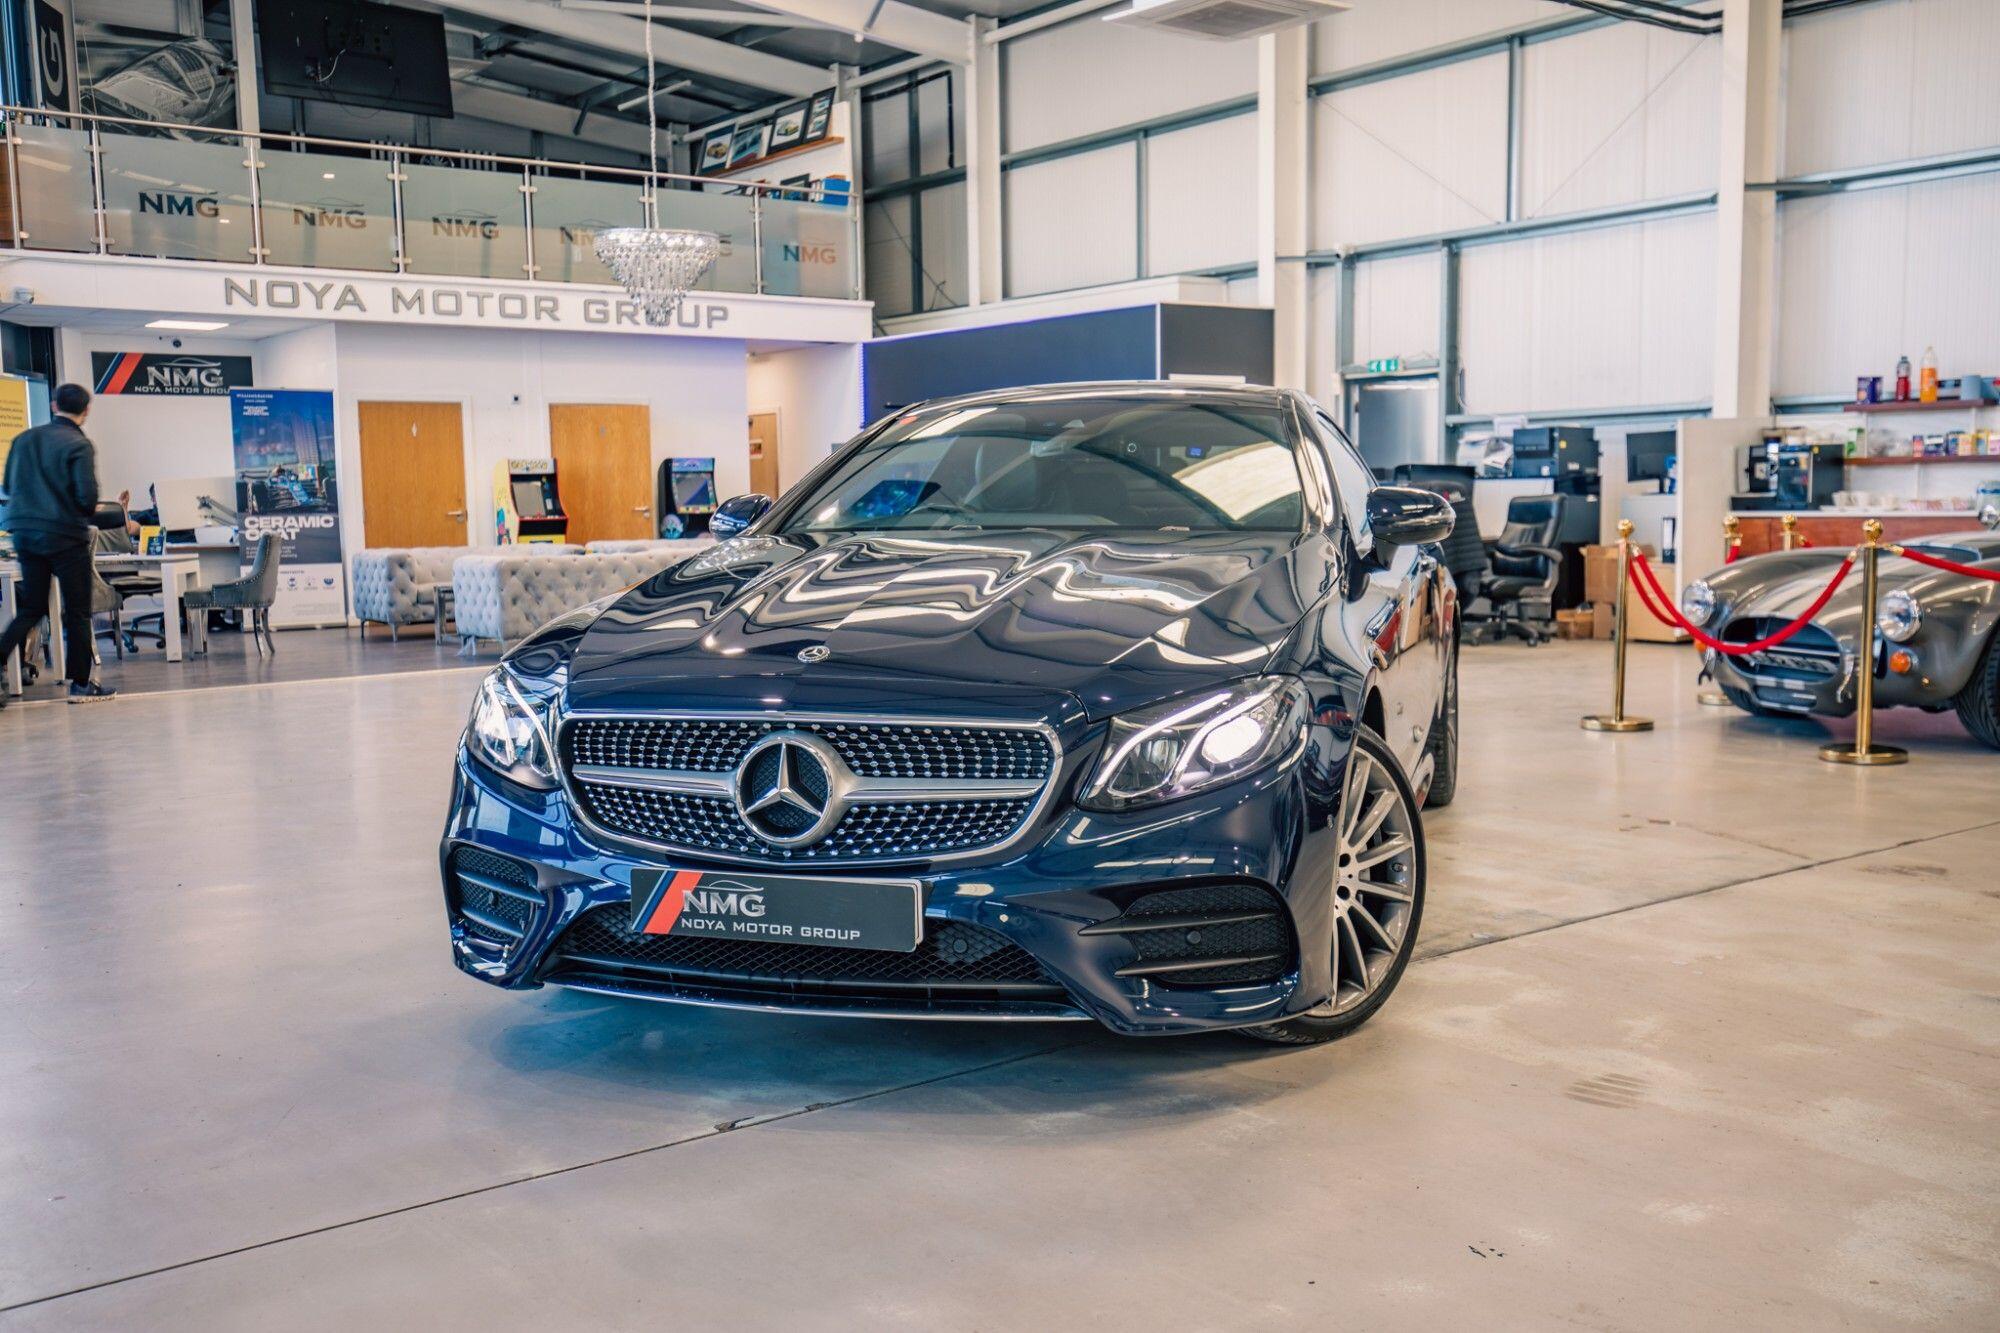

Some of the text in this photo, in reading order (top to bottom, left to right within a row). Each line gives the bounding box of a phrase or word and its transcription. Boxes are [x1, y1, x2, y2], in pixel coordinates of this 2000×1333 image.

[138, 192, 220, 218] NMG
[293, 208, 367, 229] NMG
[432, 216, 500, 239] NMG
[559, 226, 598, 246] NM
[783, 244, 836, 264] NMG
[224, 277, 367, 312] NOYA
[392, 286, 560, 321] MOTOR
[146, 366, 224, 387] NMG
[134, 385, 231, 395] NOYA MOTOR GROU
[244, 515, 334, 528] CERAMIC
[682, 889, 766, 917] NMG
[681, 917, 861, 940] NOYA MOTOR GROUP
